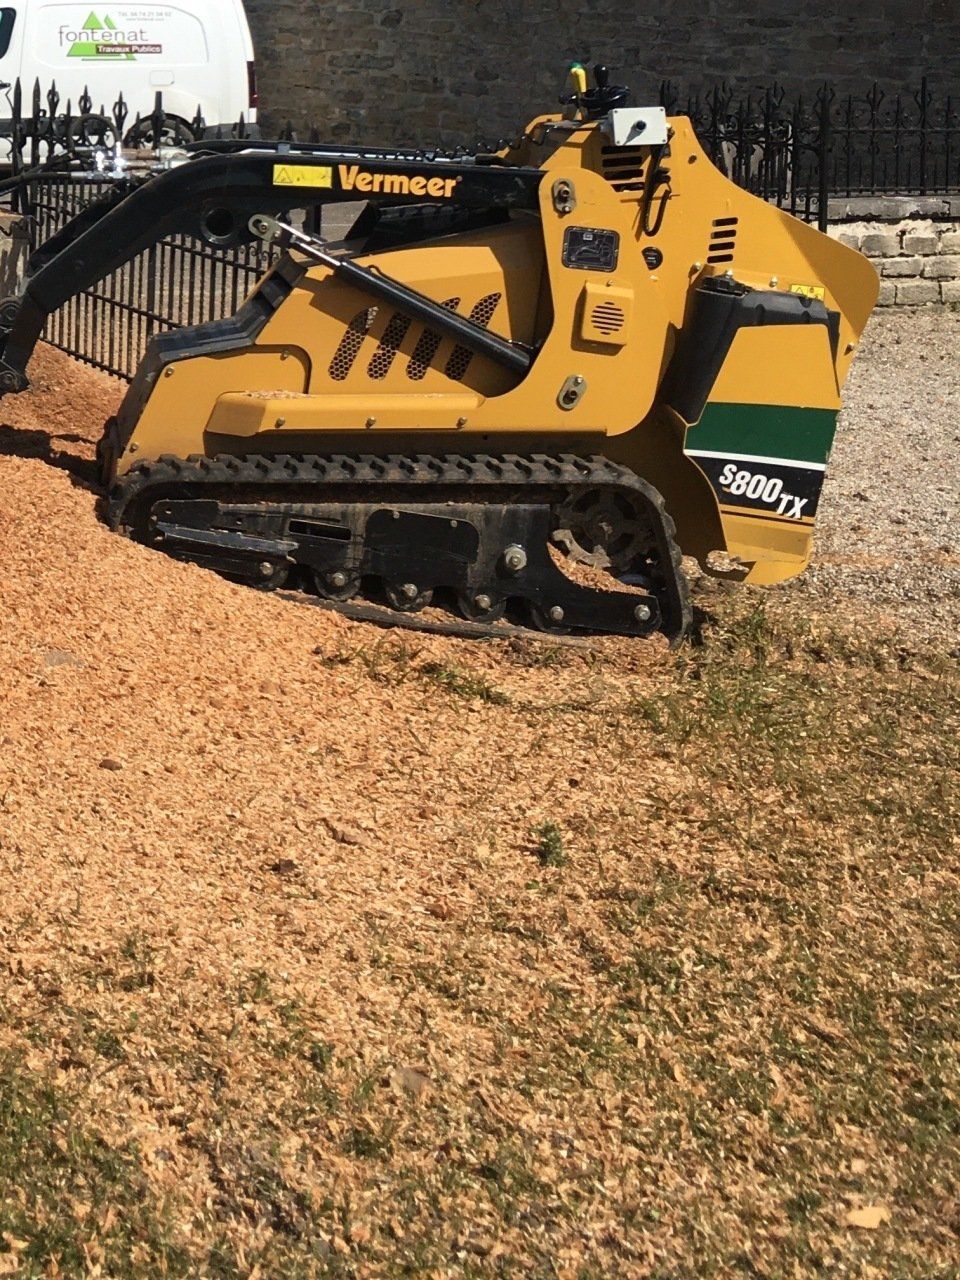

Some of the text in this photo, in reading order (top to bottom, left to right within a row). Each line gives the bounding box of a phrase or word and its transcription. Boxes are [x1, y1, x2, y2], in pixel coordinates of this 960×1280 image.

[58, 25, 149, 47] fontenat
[97, 45, 161, 53] Travaux Publics
[338, 164, 458, 198] Vermeer
